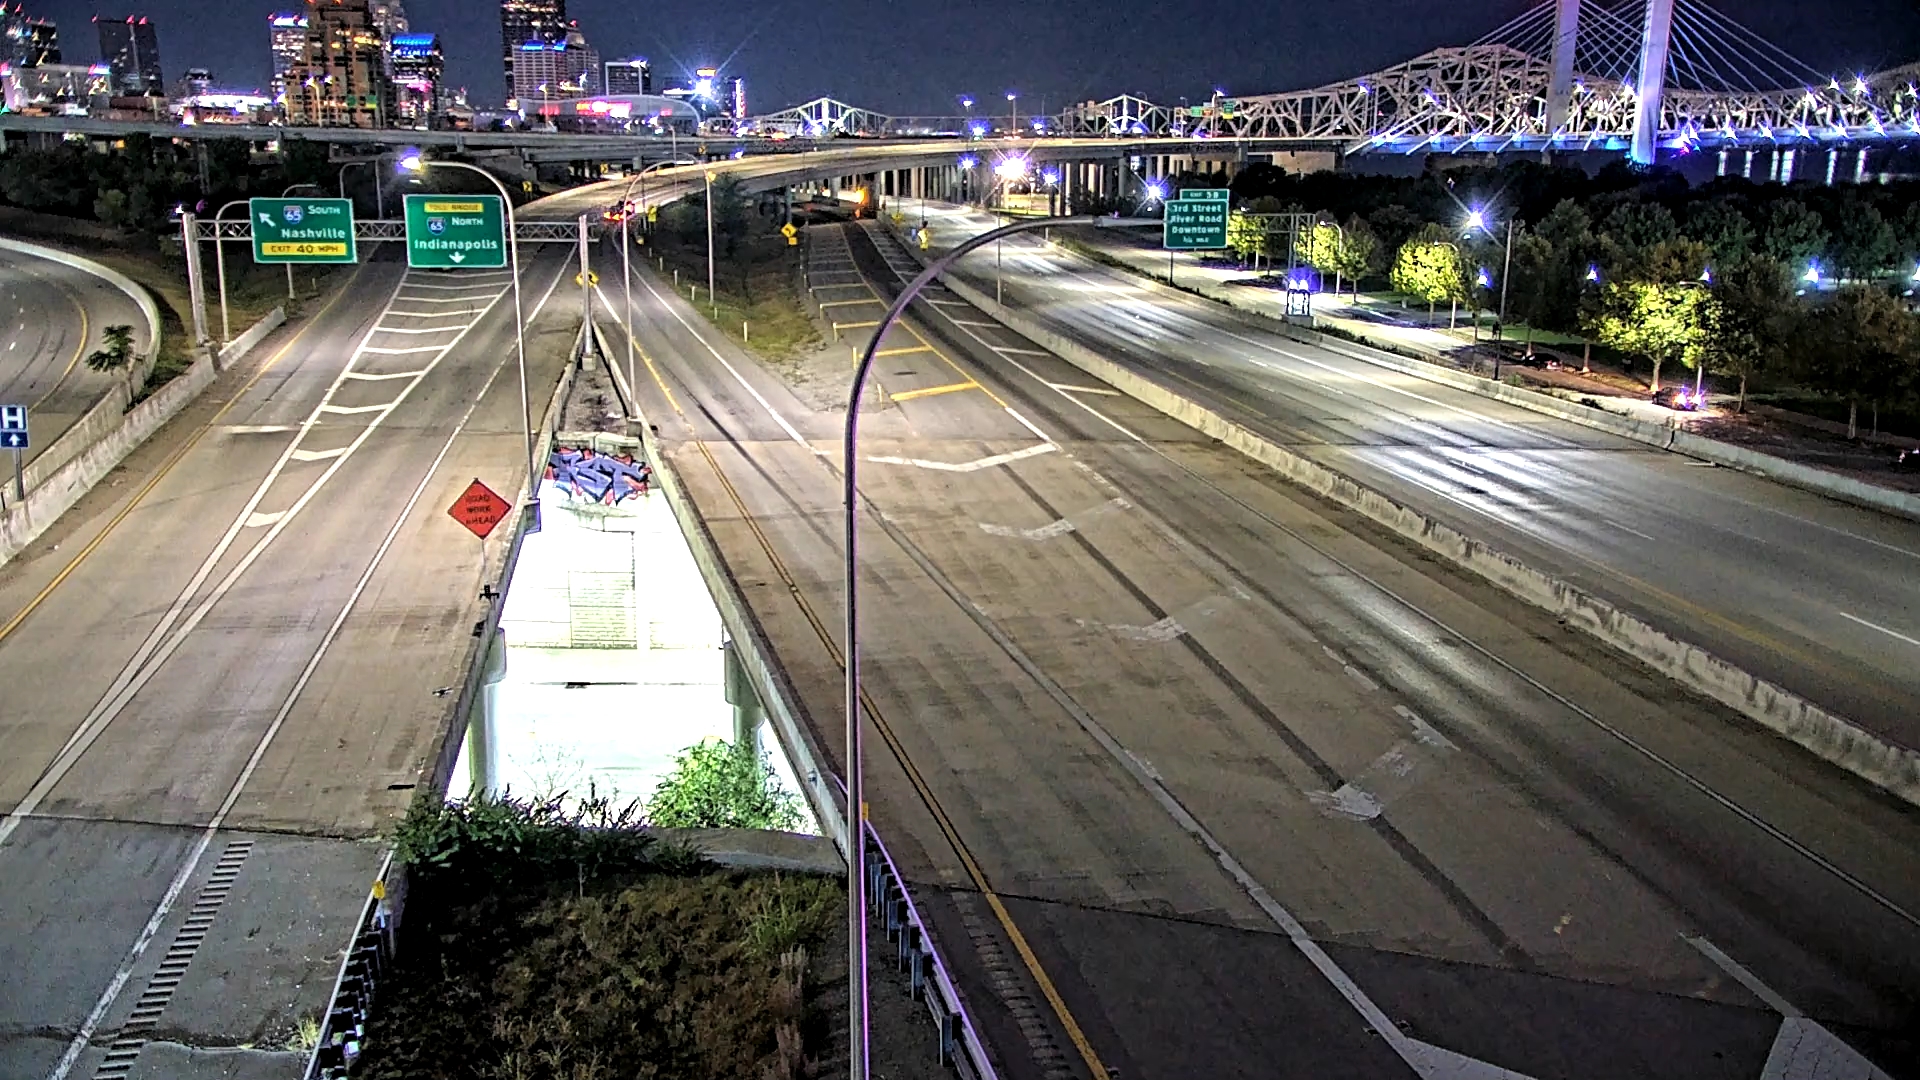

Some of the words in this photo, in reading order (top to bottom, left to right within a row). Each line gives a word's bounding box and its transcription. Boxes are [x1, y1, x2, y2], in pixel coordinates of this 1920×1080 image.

[286, 210, 302, 222] 65
[308, 205, 340, 214] SOUTH
[1172, 204, 1189, 213] 3rd
[1192, 204, 1222, 213] Street
[430, 221, 444, 231] 65
[451, 216, 484, 226] NORTH
[1170, 214, 1195, 223] River
[1198, 214, 1223, 223] Road
[281, 228, 346, 239] Nashville
[1171, 225, 1221, 234] Downtown
[270, 245, 291, 253] EXIT
[296, 244, 314, 254] 40
[317, 245, 339, 253] MPH
[414, 238, 498, 252] Indianapolis
[1, 407, 24, 429] H
[466, 505, 491, 513] WORK
